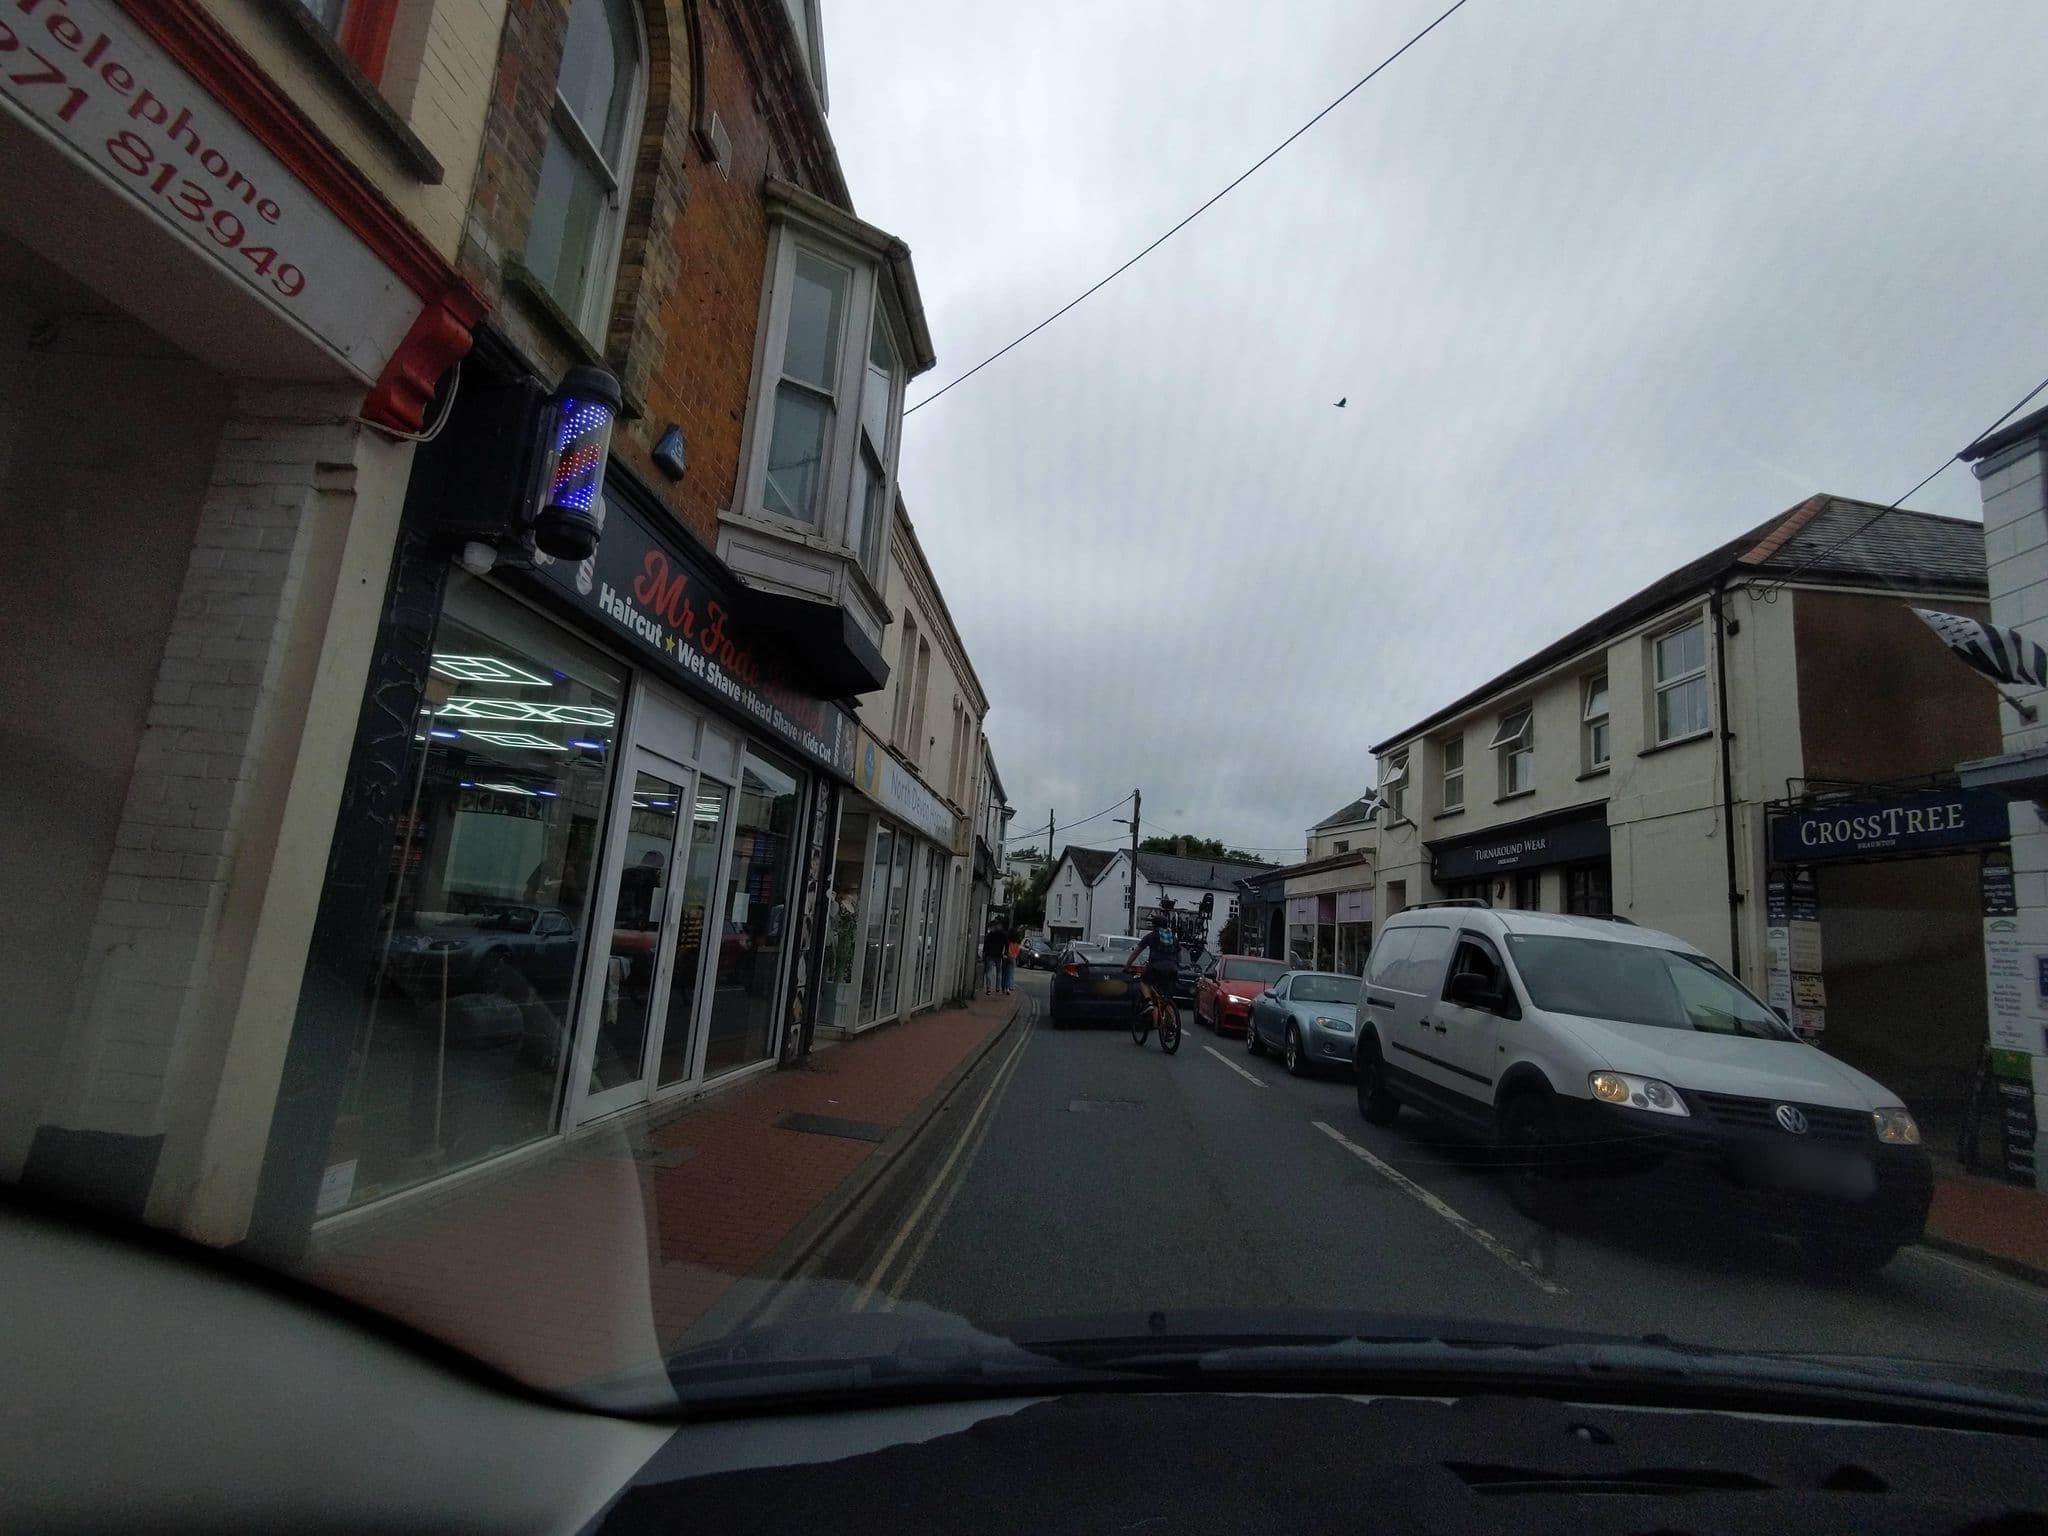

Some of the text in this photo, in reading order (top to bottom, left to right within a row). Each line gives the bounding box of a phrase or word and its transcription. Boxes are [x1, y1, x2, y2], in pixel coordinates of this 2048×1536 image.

[17, 0, 281, 225] elephone
[106, 130, 305, 298] 813949
[599, 582, 663, 649] Haircut
[677, 638, 705, 678] Wet
[707, 662, 741, 702] Shave
[747, 691, 773, 725] Head
[773, 709, 798, 740] Shave
[803, 730, 818, 754] Kids
[819, 740, 832, 764] Cut
[633, 549, 695, 638] Mr
[1523, 838, 1546, 851] WEAR
